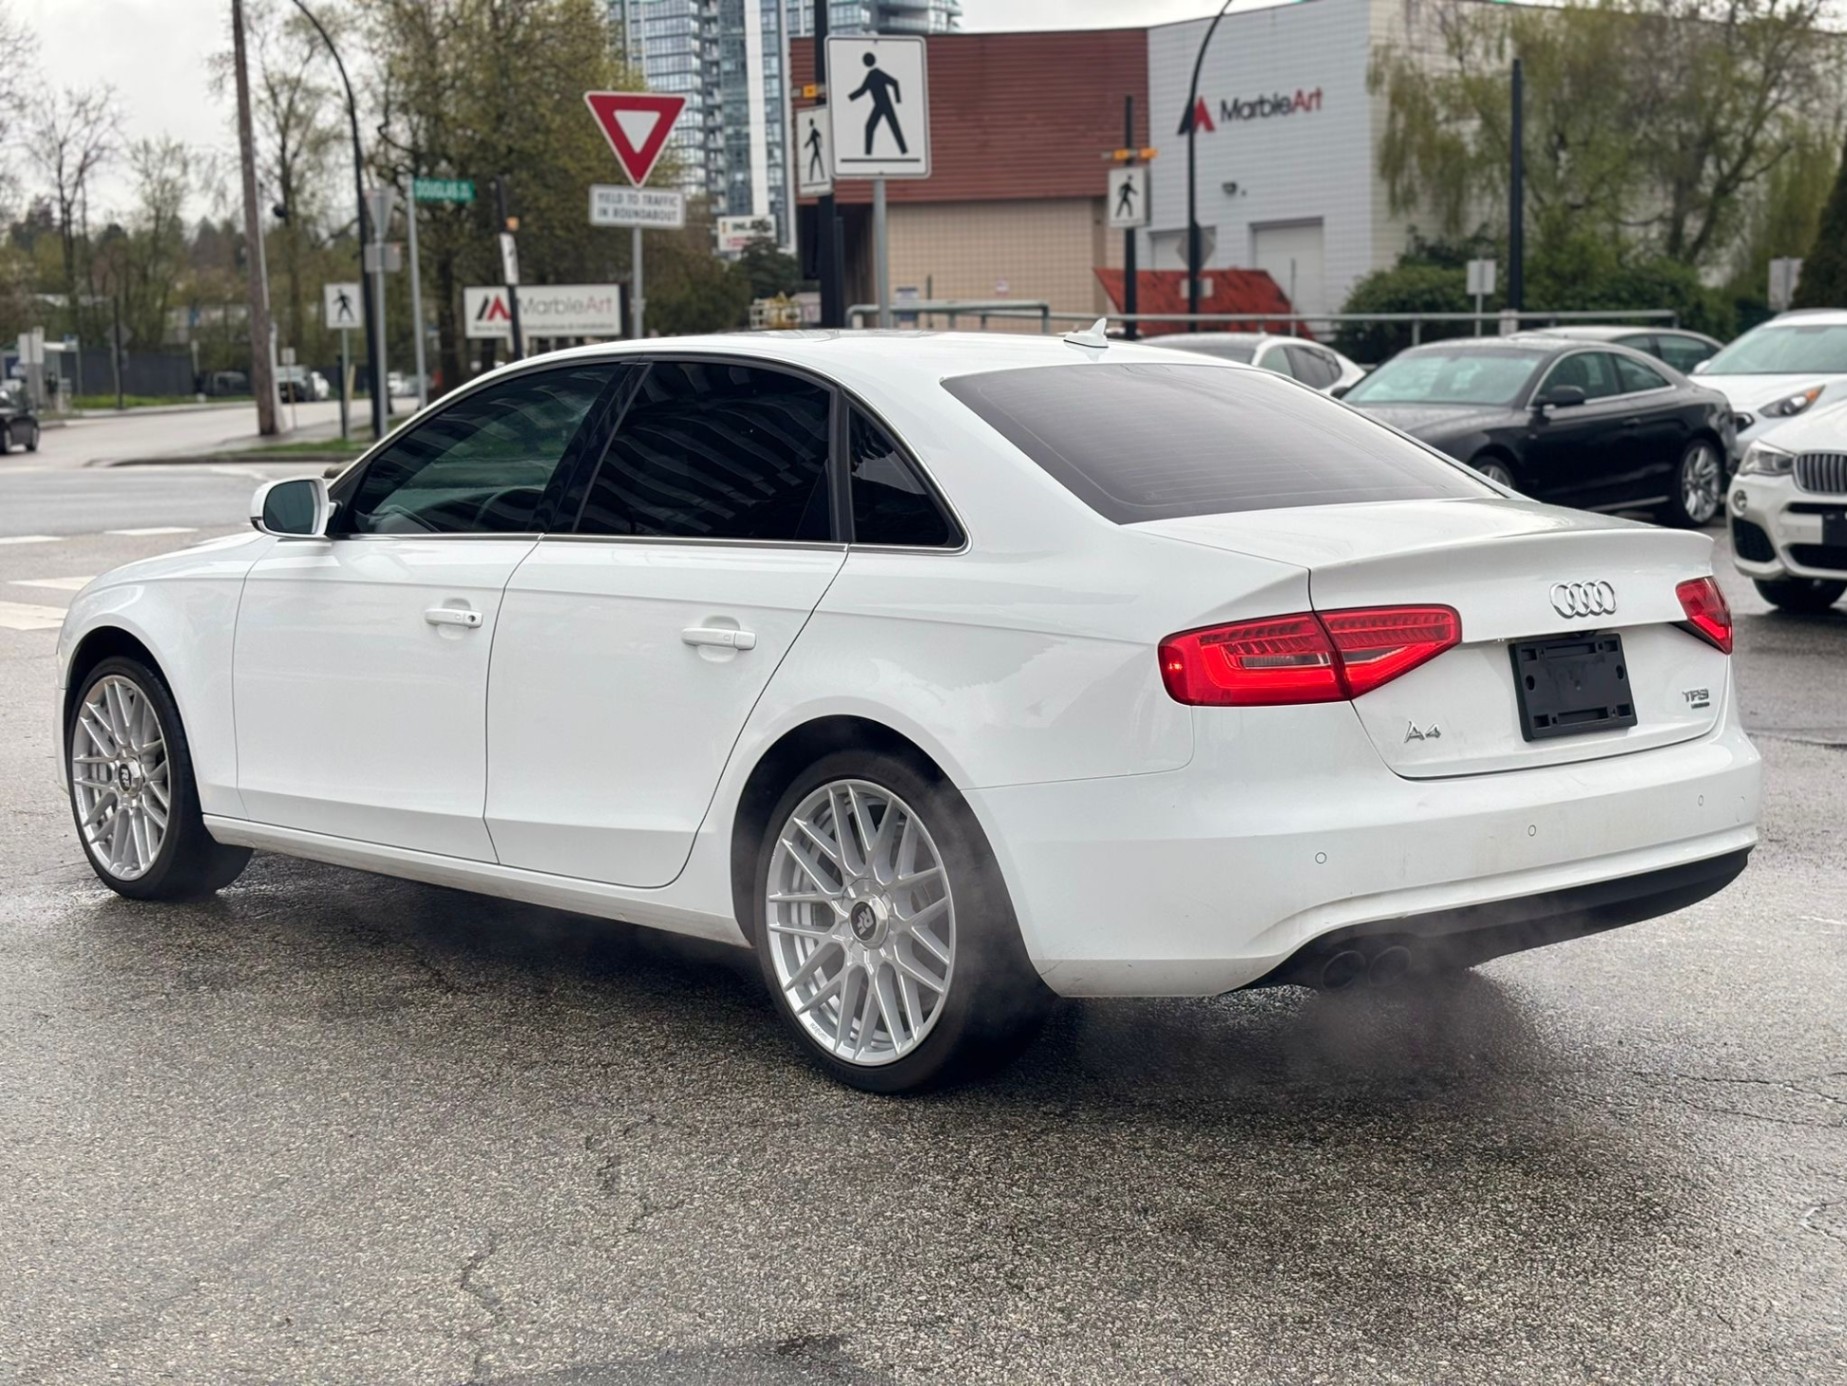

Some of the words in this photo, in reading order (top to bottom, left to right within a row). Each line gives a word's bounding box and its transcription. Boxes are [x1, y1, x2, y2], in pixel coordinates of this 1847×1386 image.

[1220, 85, 1323, 123] MarbleArt
[597, 192, 624, 205] YIELD
[627, 193, 640, 206] TO
[642, 194, 679, 207] TRAFFIC
[597, 206, 610, 218] IN
[613, 206, 678, 221] ROUNDABOUT
[1403, 720, 1442, 744] A4
